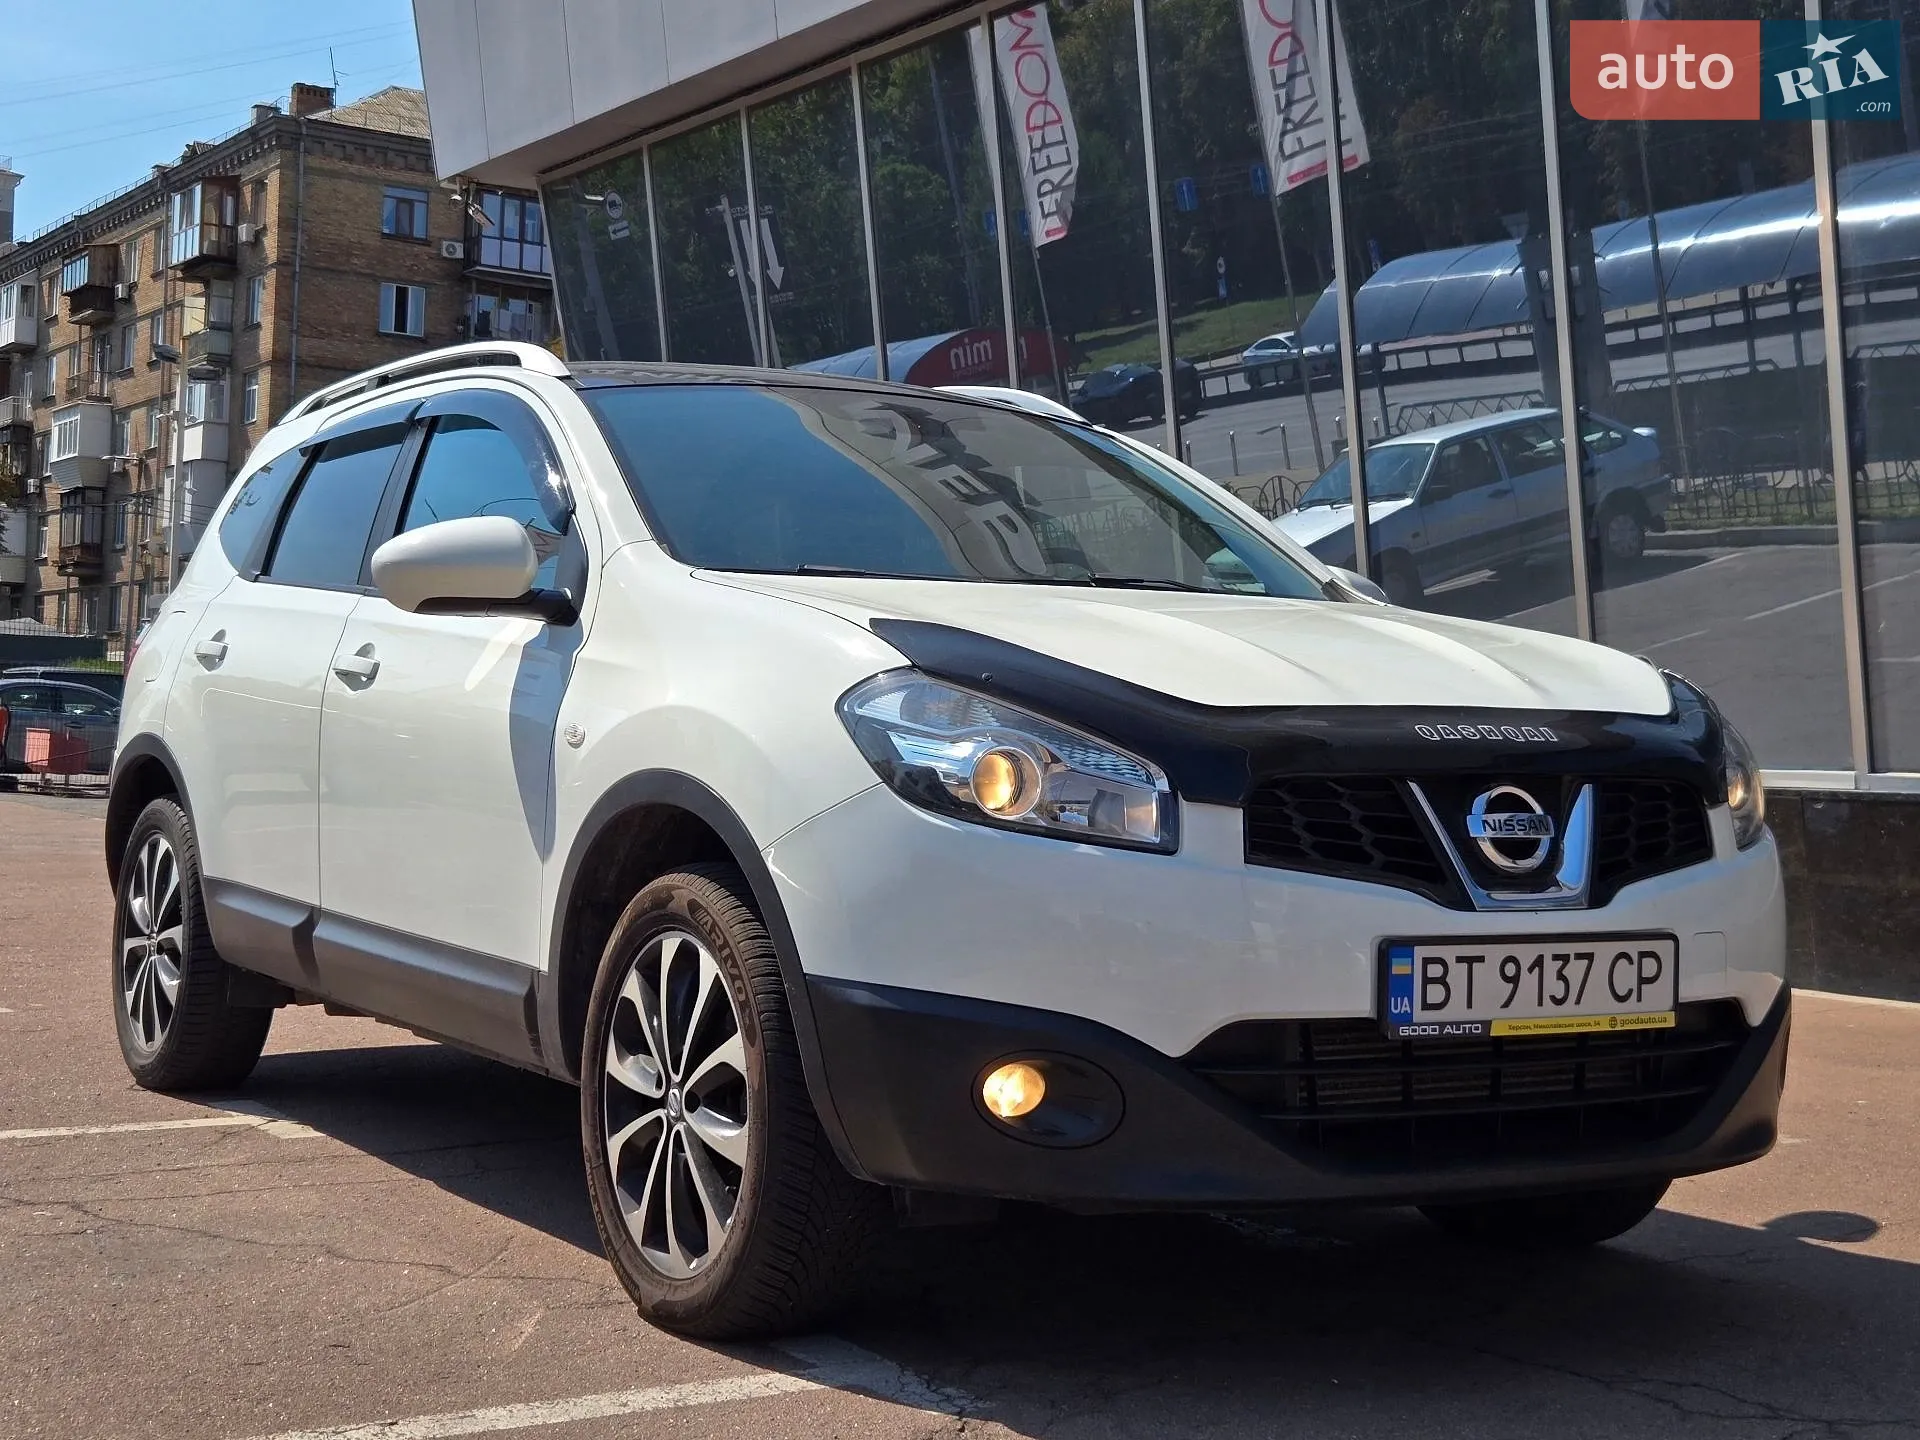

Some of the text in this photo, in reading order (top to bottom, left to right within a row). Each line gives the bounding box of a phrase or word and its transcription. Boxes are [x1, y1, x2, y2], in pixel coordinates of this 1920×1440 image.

[1415, 725, 1558, 742] QASHQAI
[1481, 817, 1550, 833] NISSAN
[701, 914, 747, 1003] ARIVO
[1420, 950, 1663, 1011] BT 9137 CP
[1391, 996, 1412, 1014] UA
[1399, 1023, 1482, 1036] GOOD AUTO
[1619, 1015, 1667, 1028] goodauto.ua
